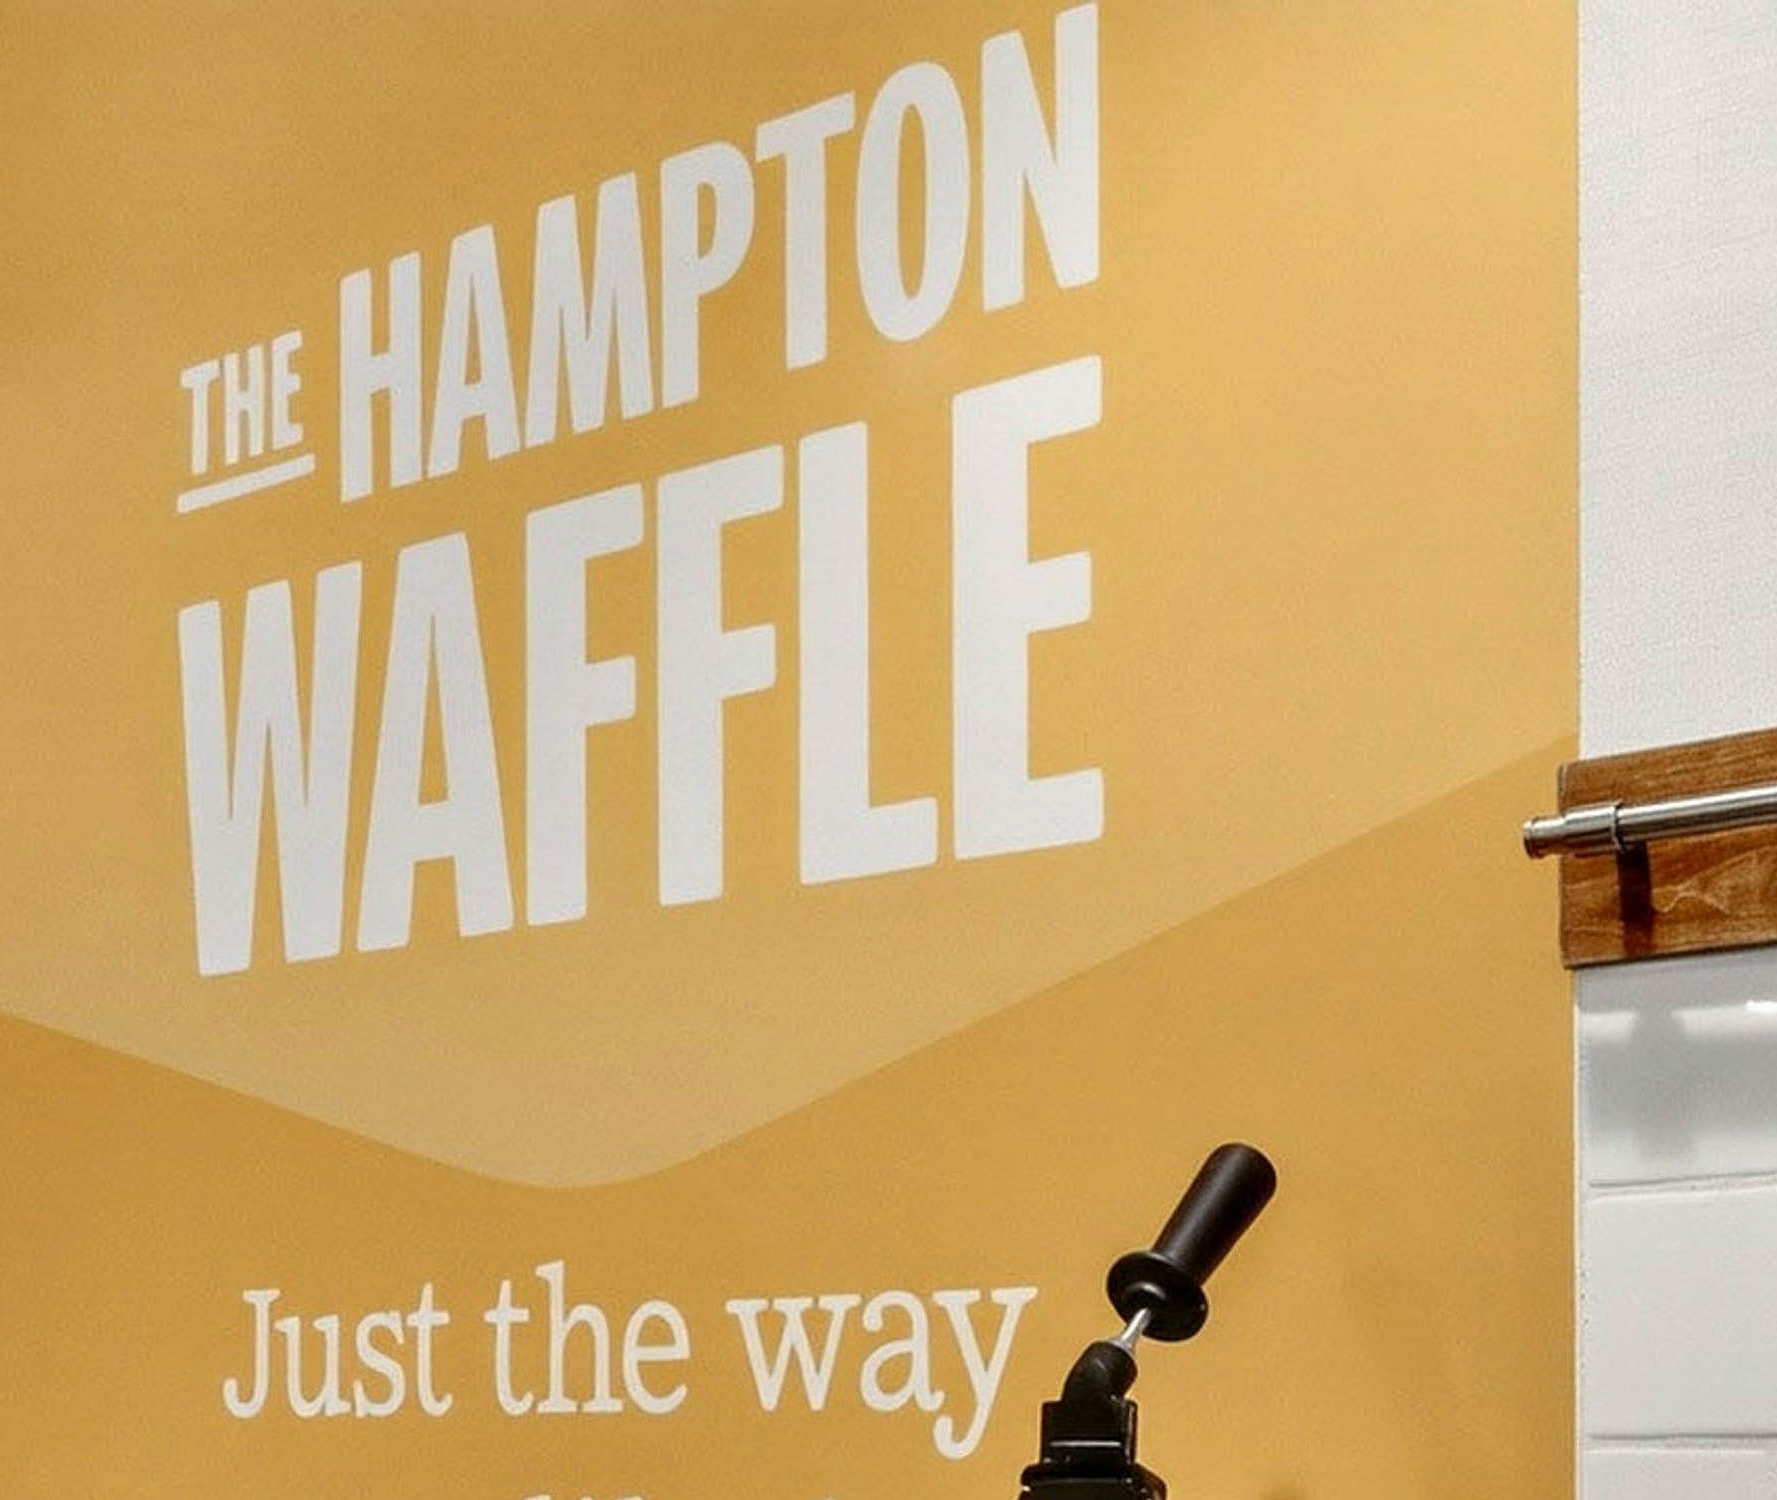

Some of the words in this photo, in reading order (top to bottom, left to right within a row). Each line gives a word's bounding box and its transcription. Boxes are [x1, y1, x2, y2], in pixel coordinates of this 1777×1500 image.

[179, 330, 305, 476] THE
[338, 2, 1100, 504] HAMPTON
[177, 354, 1105, 978] WAFFLE
[222, 1282, 455, 1419] Just
[483, 1259, 690, 1416] the
[725, 1286, 1038, 1461] way
